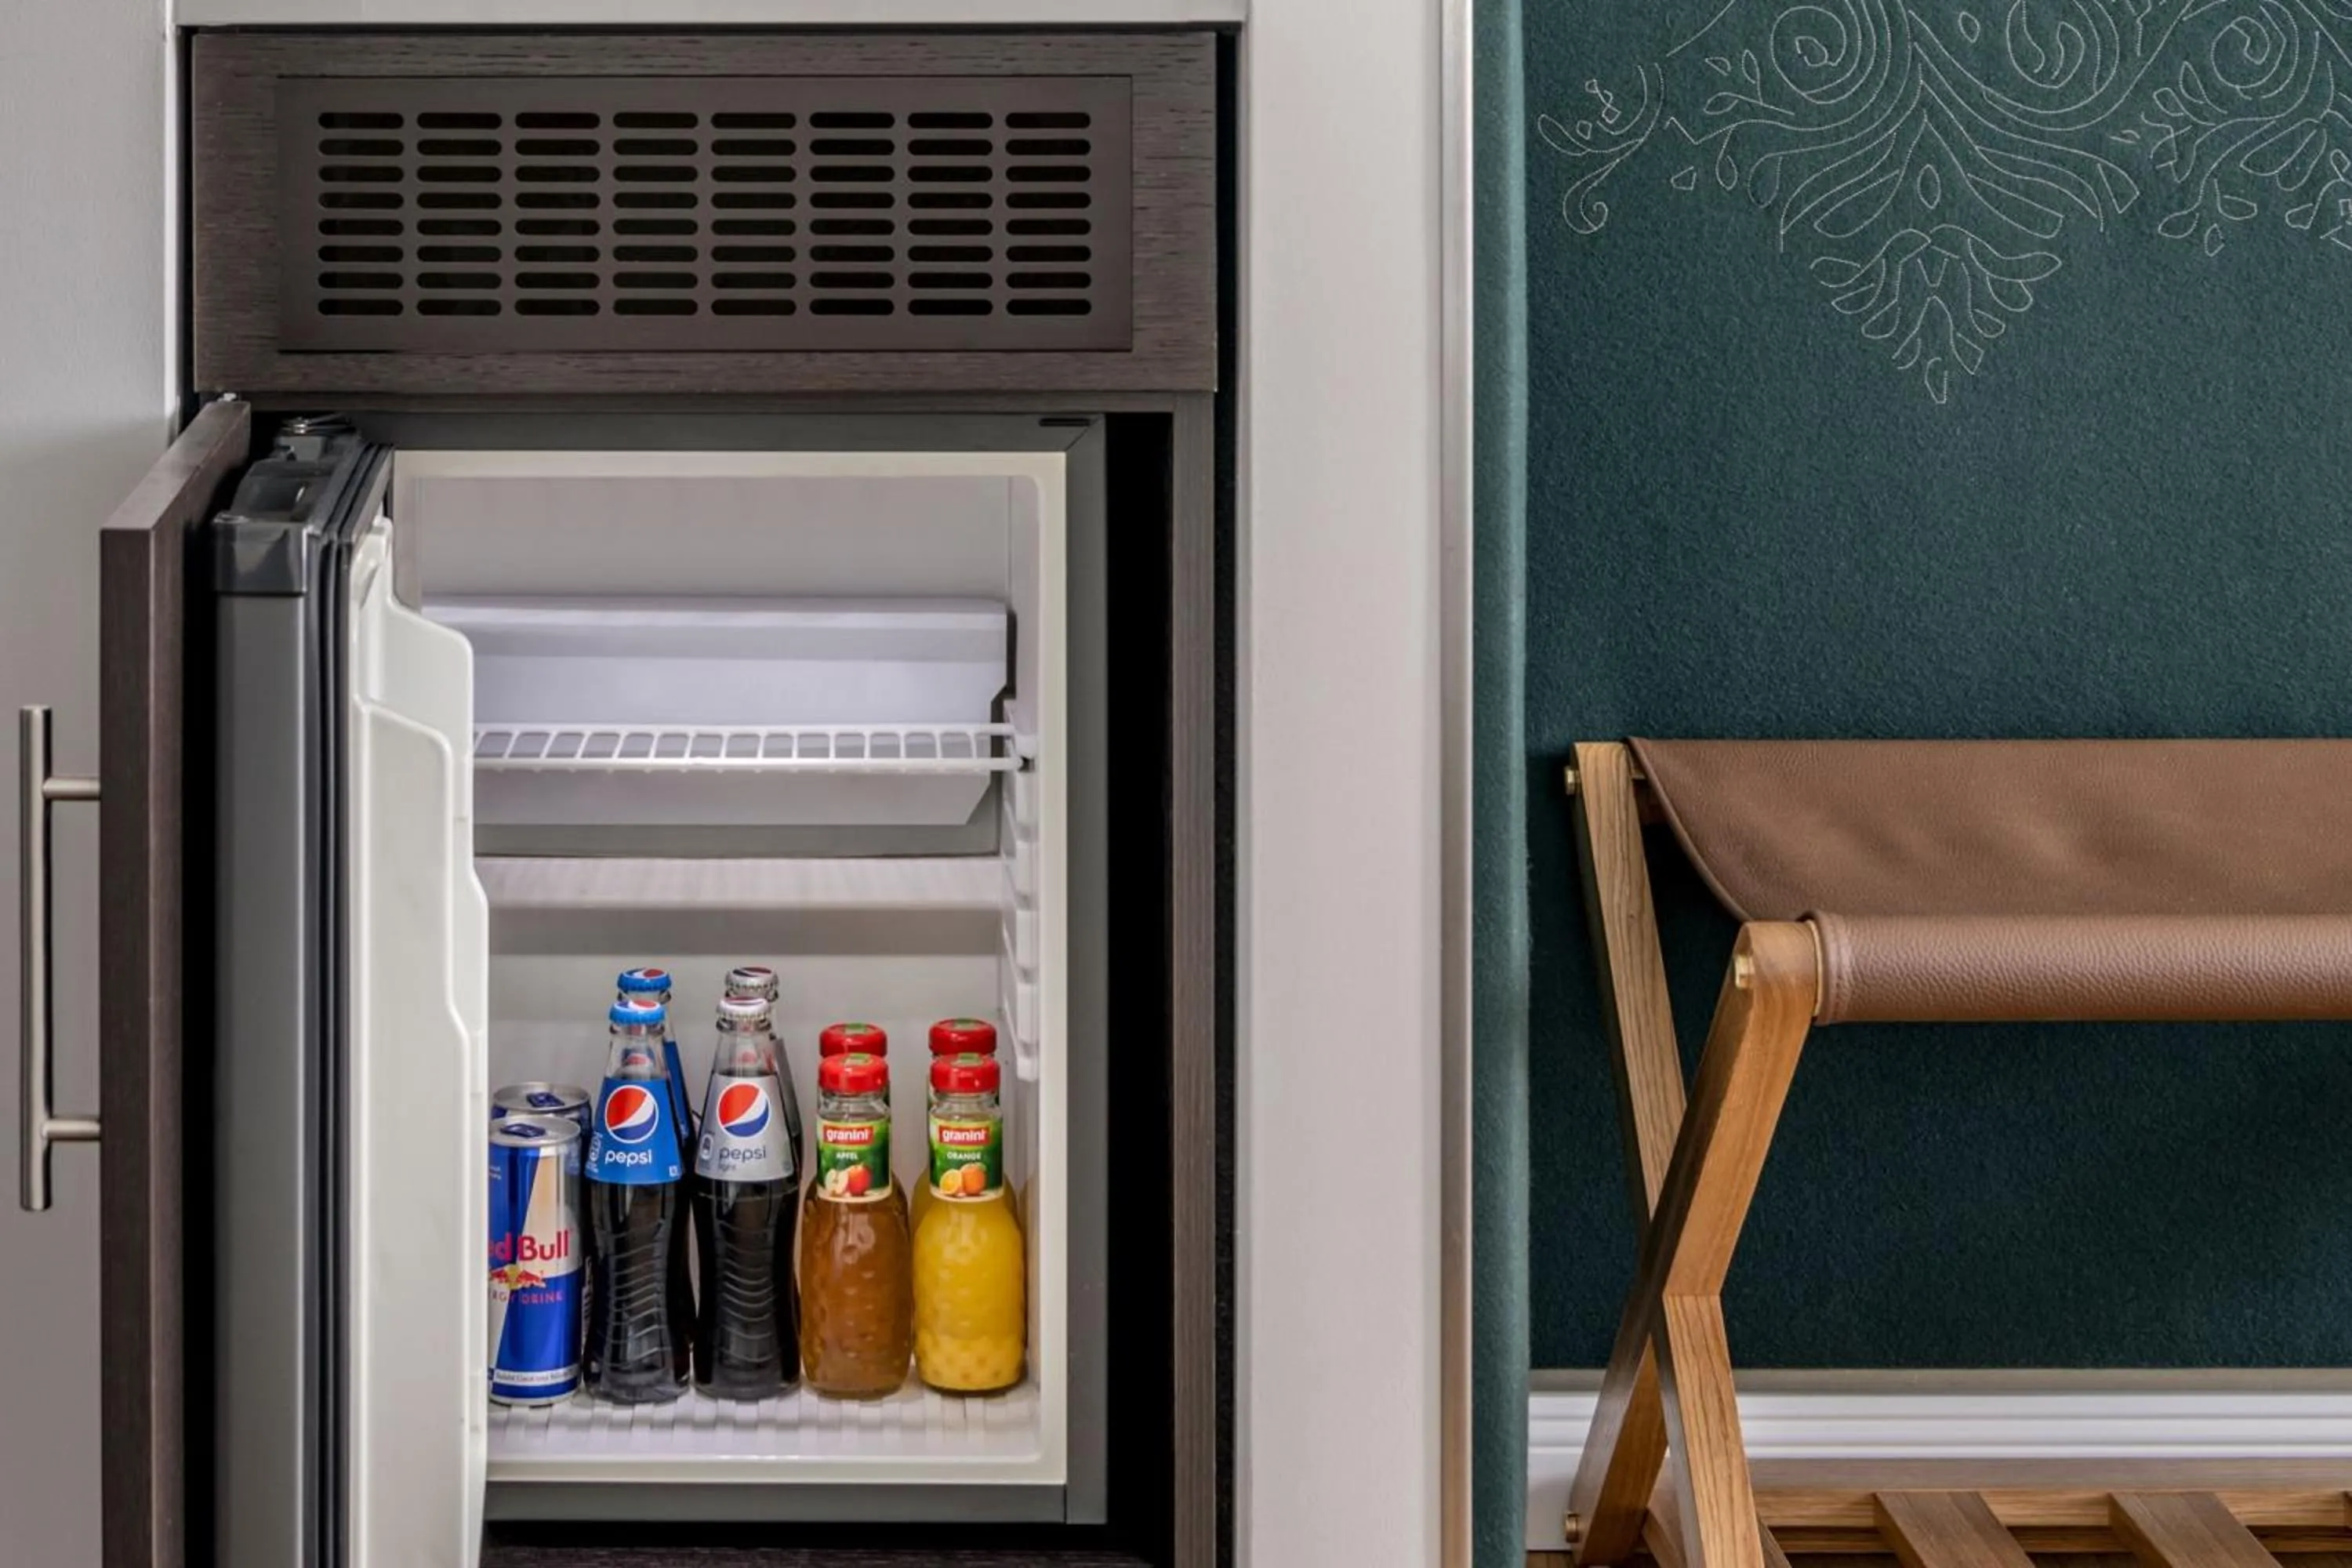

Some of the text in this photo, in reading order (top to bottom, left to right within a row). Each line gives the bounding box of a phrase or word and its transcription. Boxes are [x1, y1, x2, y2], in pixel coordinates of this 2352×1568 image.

[826, 1129, 869, 1142] granini
[942, 1129, 986, 1142] granini
[604, 1149, 652, 1167] pepsi
[719, 1145, 767, 1163] pepsi
[946, 1151, 982, 1160] ORANGE
[518, 1229, 569, 1261] Bull
[521, 1290, 563, 1305] DRINK
